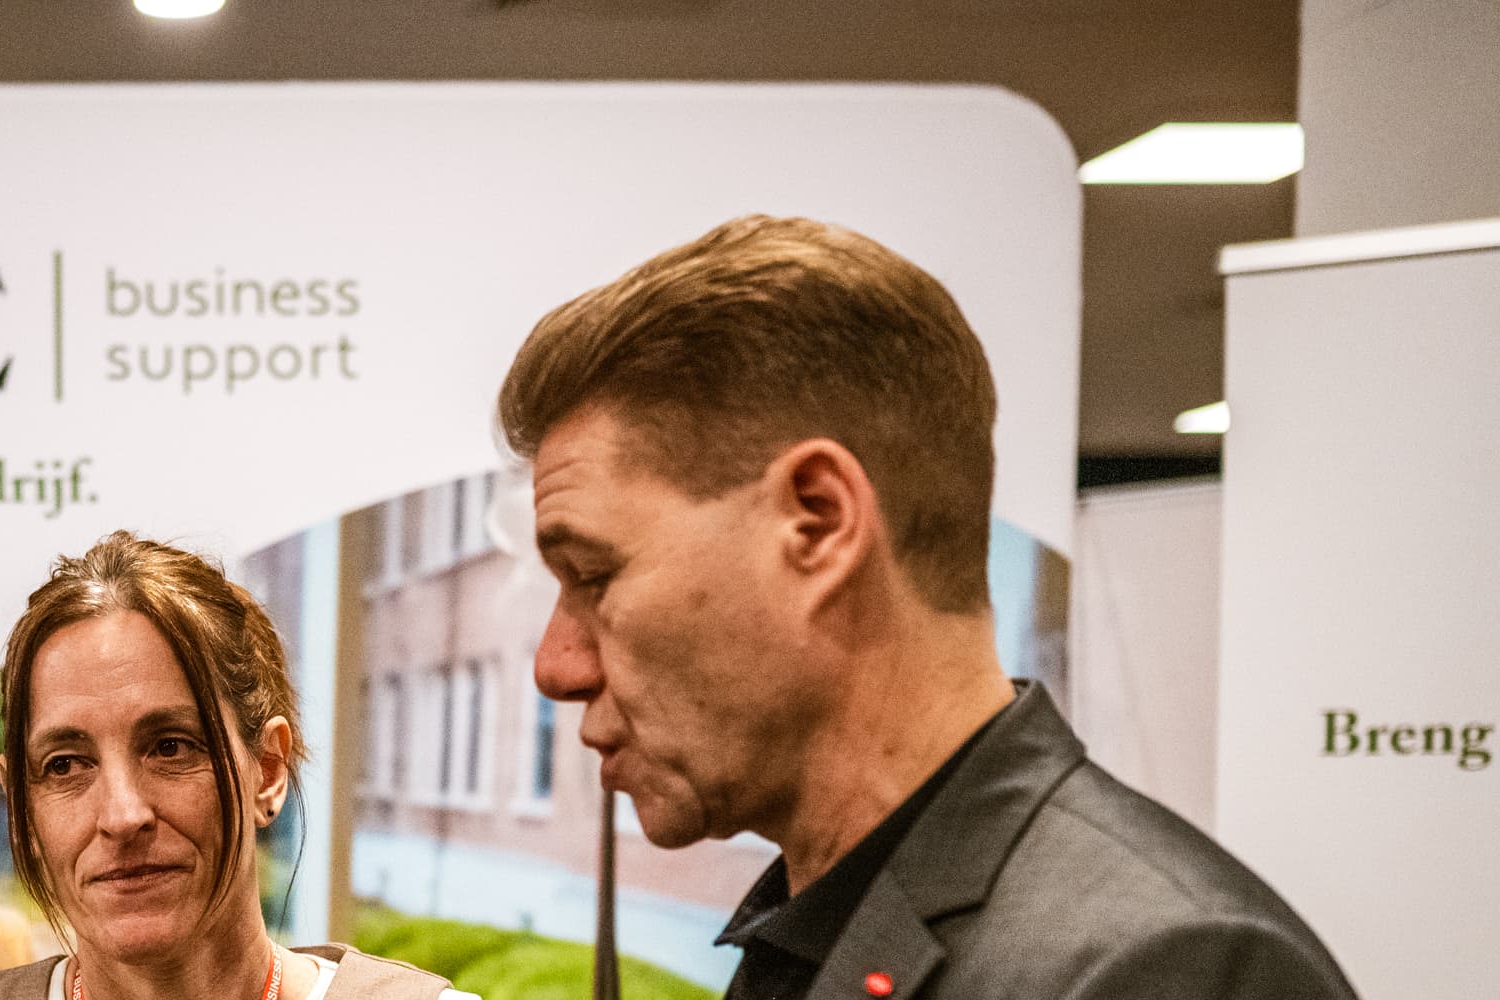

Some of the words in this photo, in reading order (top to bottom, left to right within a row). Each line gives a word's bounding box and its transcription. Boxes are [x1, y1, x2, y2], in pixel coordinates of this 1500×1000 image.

[107, 268, 361, 317] business
[106, 335, 360, 394] support
[1321, 709, 1493, 769] Breng
